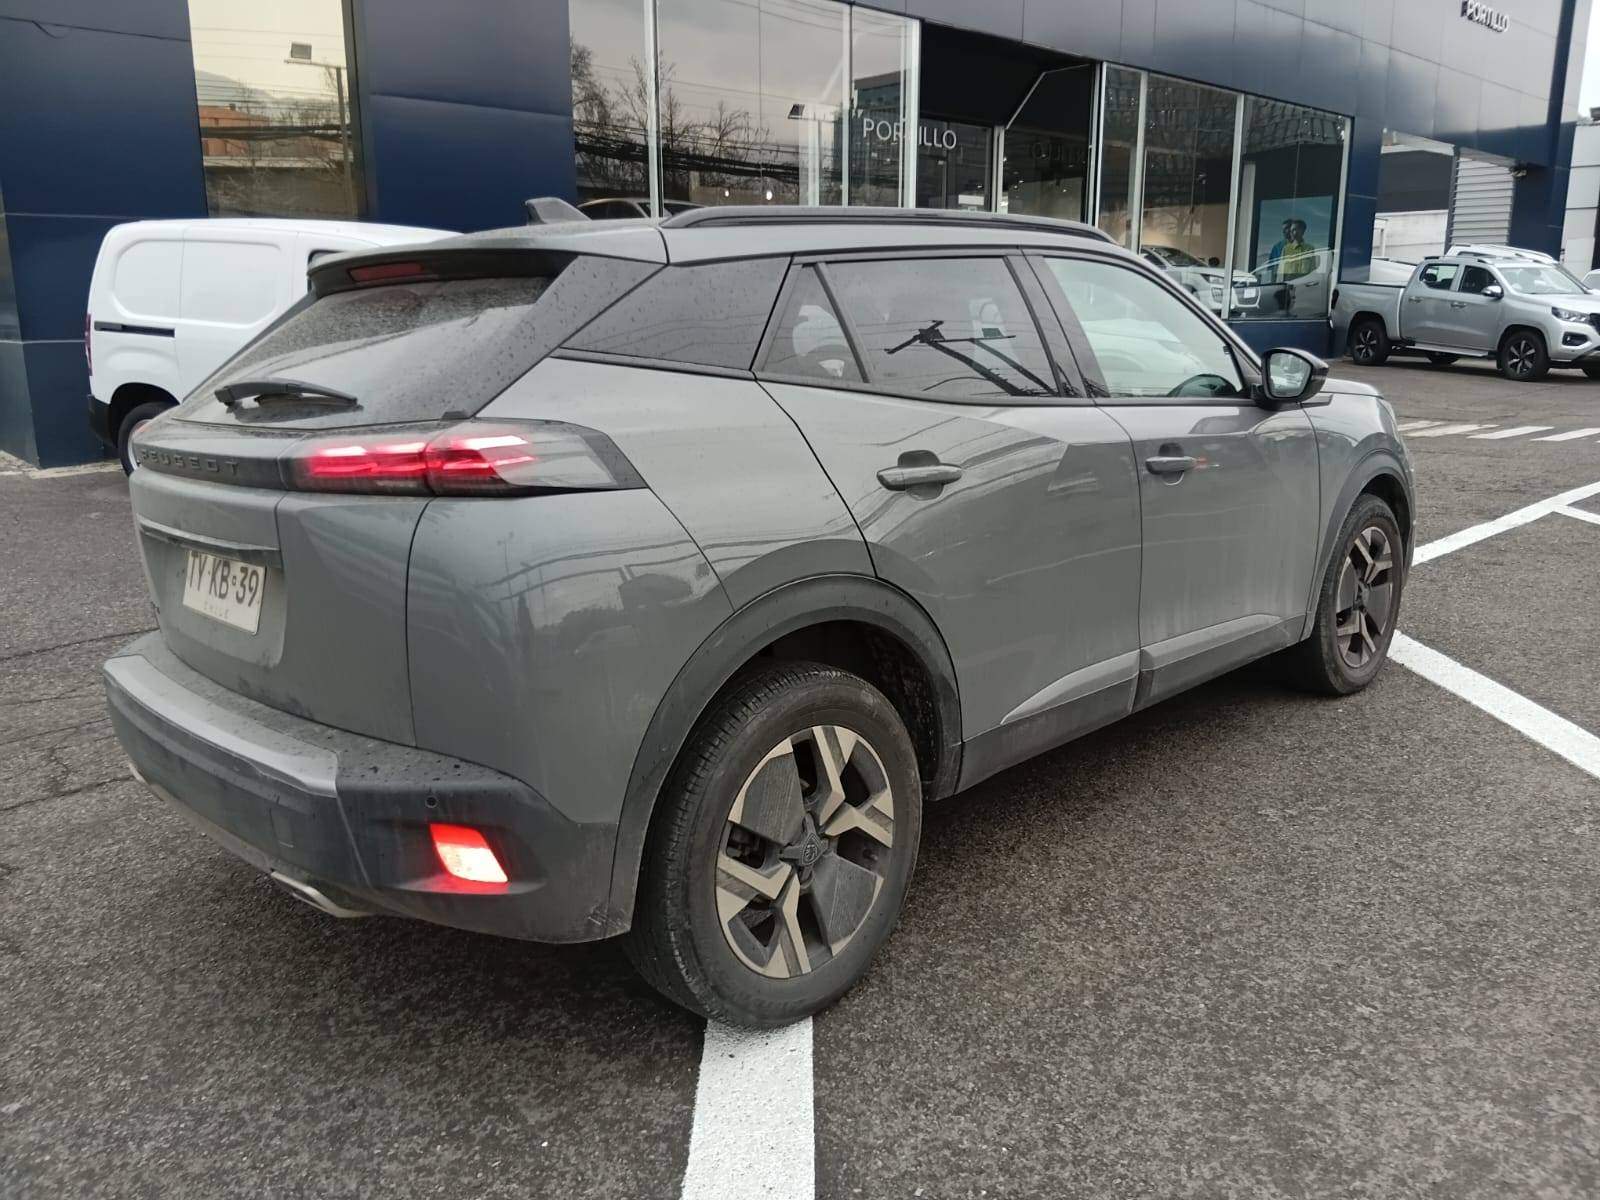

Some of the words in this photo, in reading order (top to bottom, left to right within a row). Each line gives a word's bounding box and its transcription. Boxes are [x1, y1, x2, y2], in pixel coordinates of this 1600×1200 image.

[1464, 0, 1509, 32] PORTILLO
[863, 117, 957, 149] PORILLO
[141, 448, 240, 476] PEUGEOT
